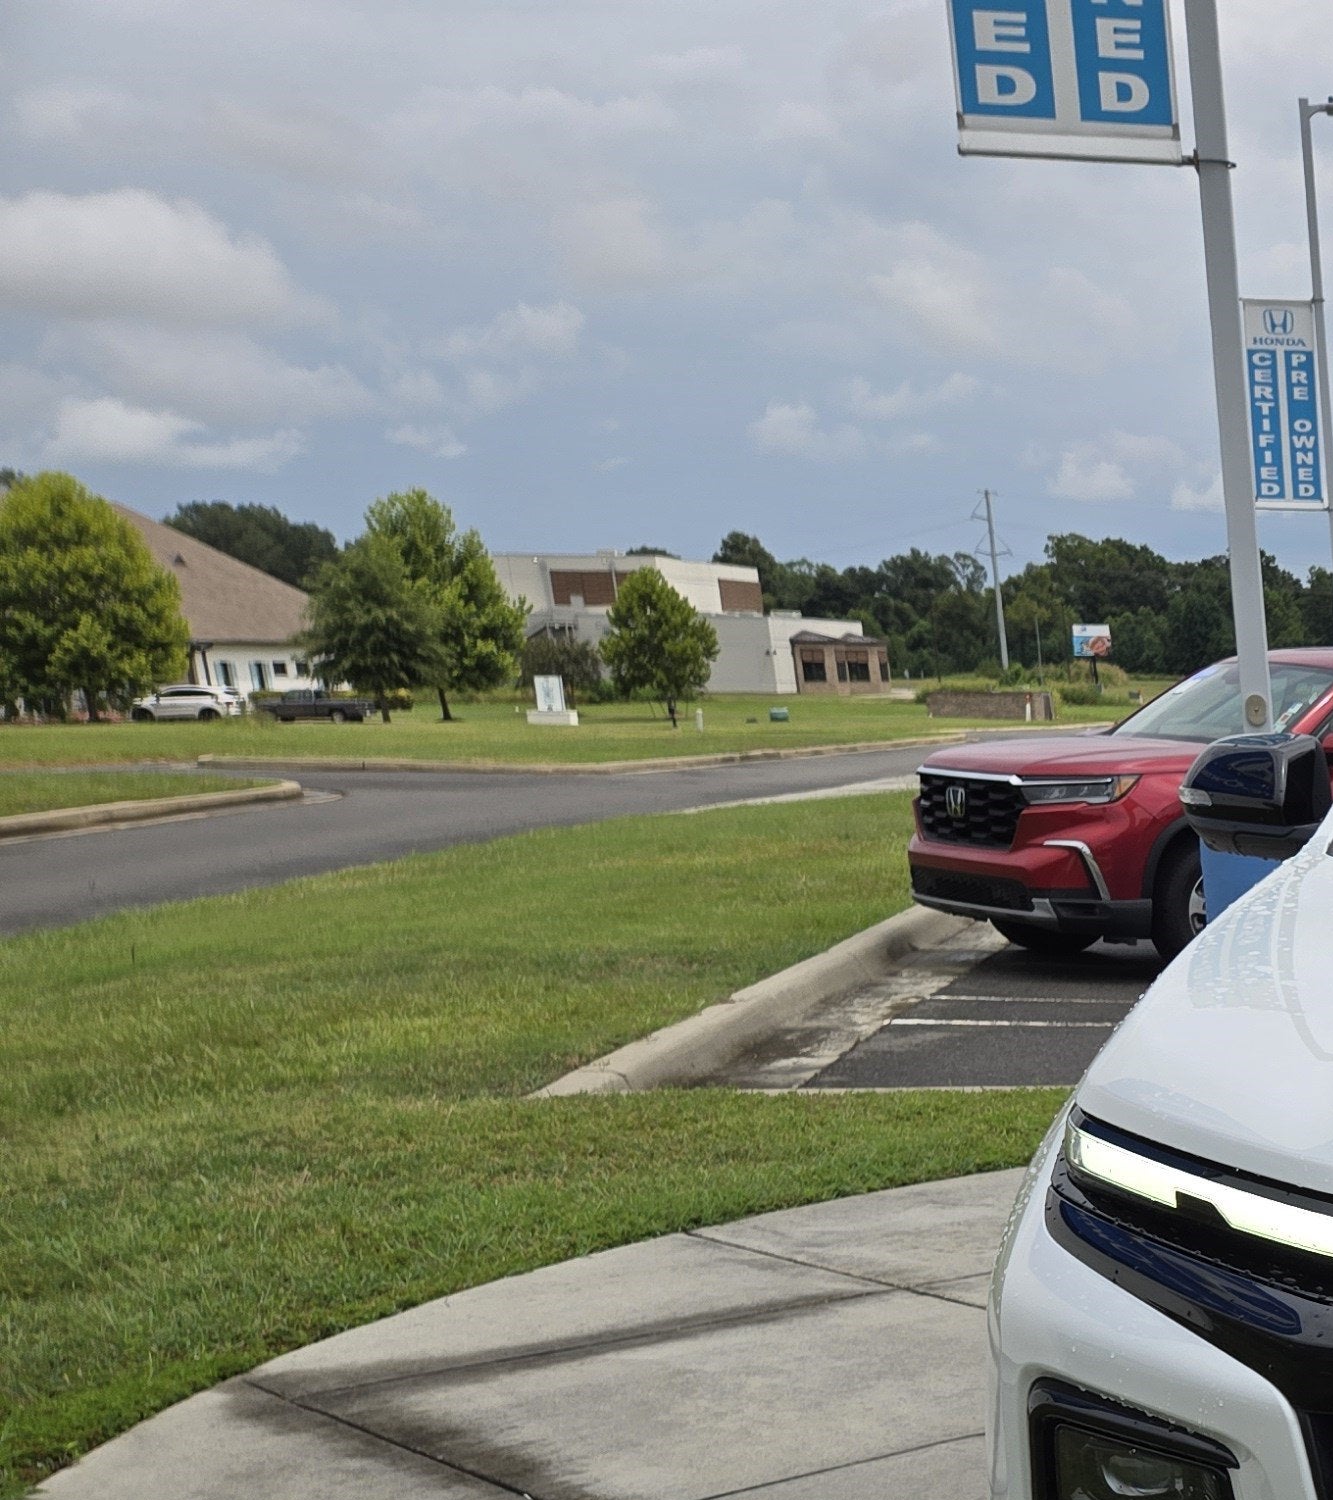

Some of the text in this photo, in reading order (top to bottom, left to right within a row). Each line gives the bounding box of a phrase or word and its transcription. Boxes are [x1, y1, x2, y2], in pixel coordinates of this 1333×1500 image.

[1090, 0, 1150, 113] ED
[1252, 336, 1307, 347] HONDA
[1252, 352, 1280, 496] CERTIFIED
[1291, 353, 1316, 497] PRE OWNED
